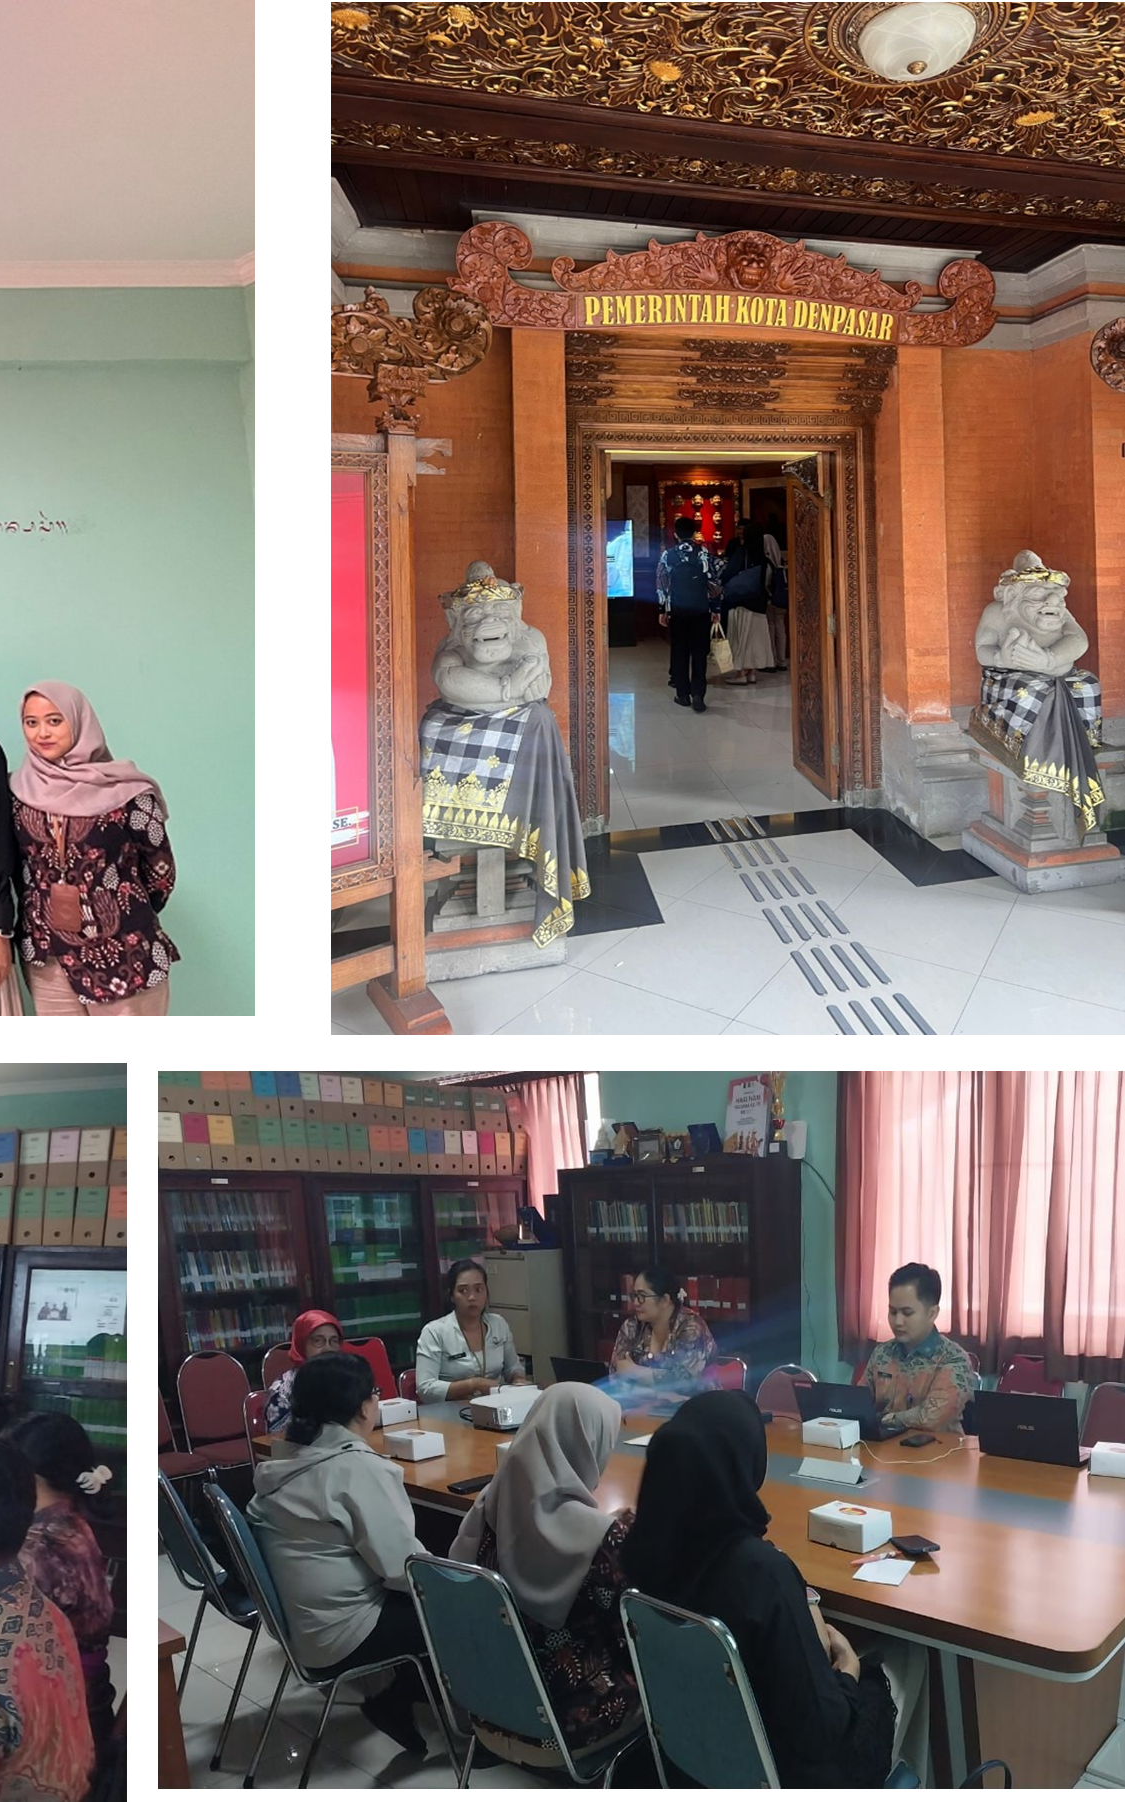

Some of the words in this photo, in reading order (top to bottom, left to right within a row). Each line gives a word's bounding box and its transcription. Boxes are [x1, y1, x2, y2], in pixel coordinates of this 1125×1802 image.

[584, 294, 730, 325] PEMERINTAH
[735, 295, 787, 327] KOTA
[792, 300, 894, 341] DENPASAR
